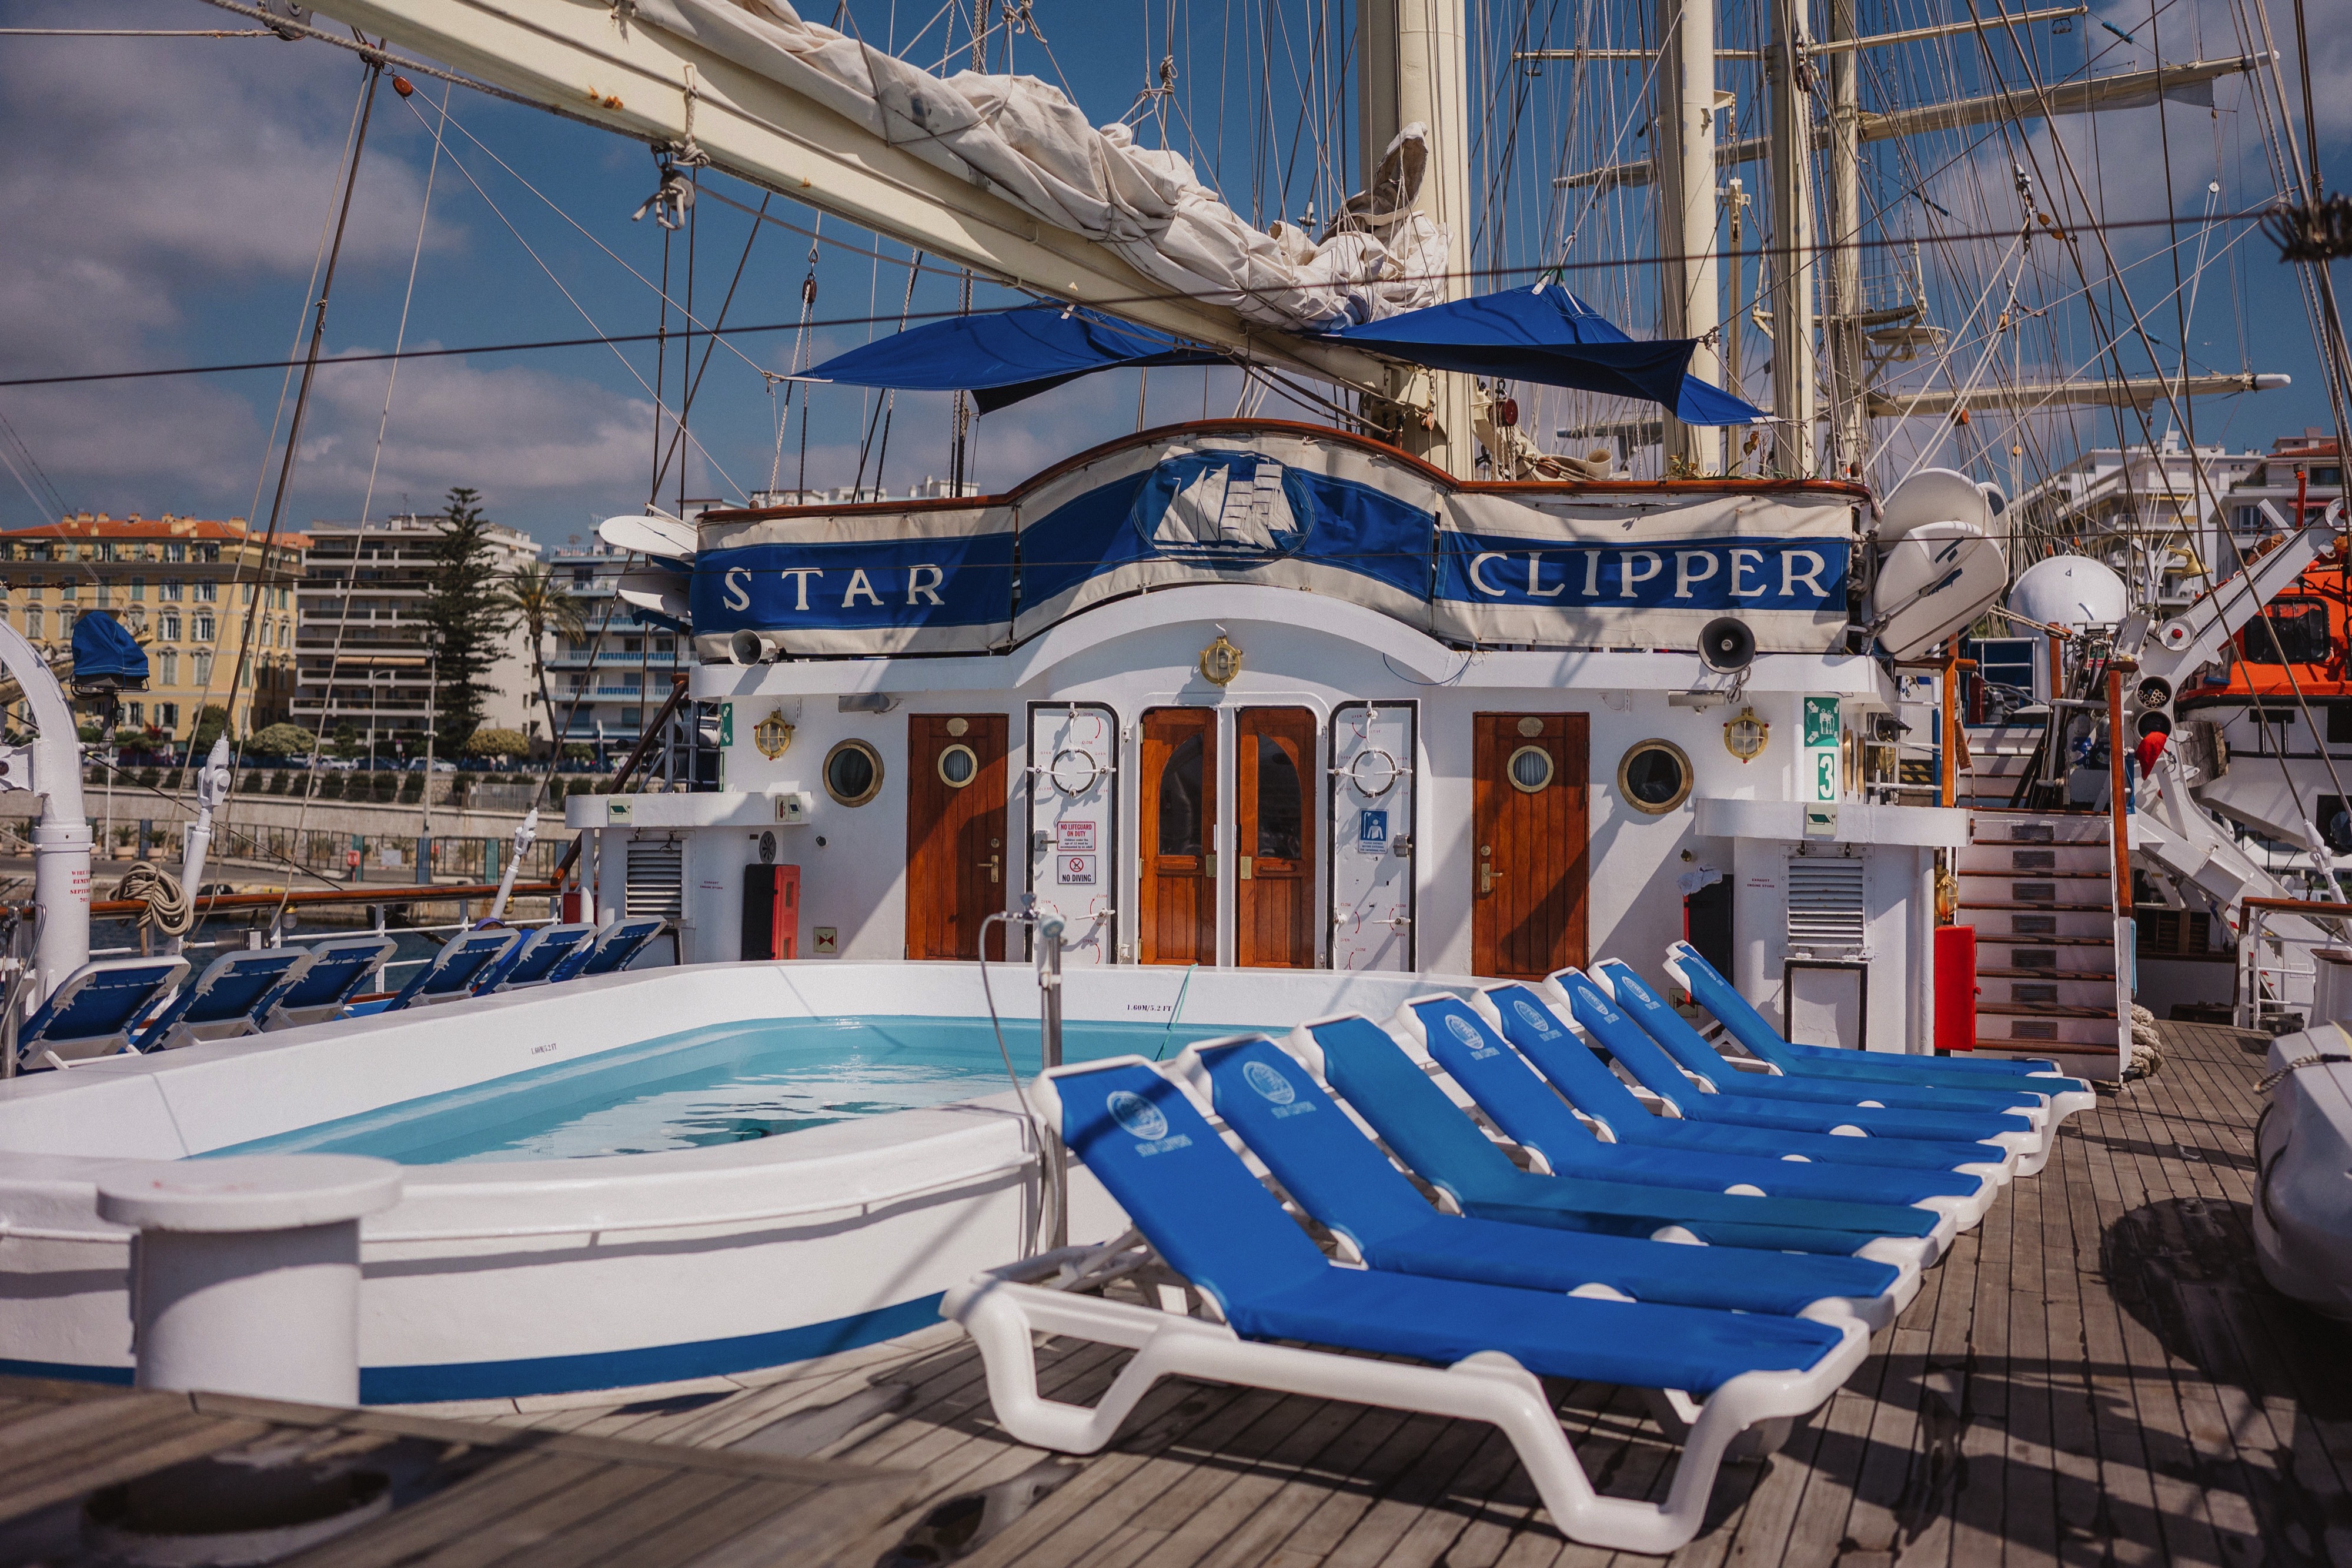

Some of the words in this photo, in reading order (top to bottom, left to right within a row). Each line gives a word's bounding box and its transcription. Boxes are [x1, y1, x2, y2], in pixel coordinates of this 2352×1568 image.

[723, 563, 945, 612] STAR
[1469, 549, 1830, 598] CLIPPER
[1819, 755, 1834, 798] 3
